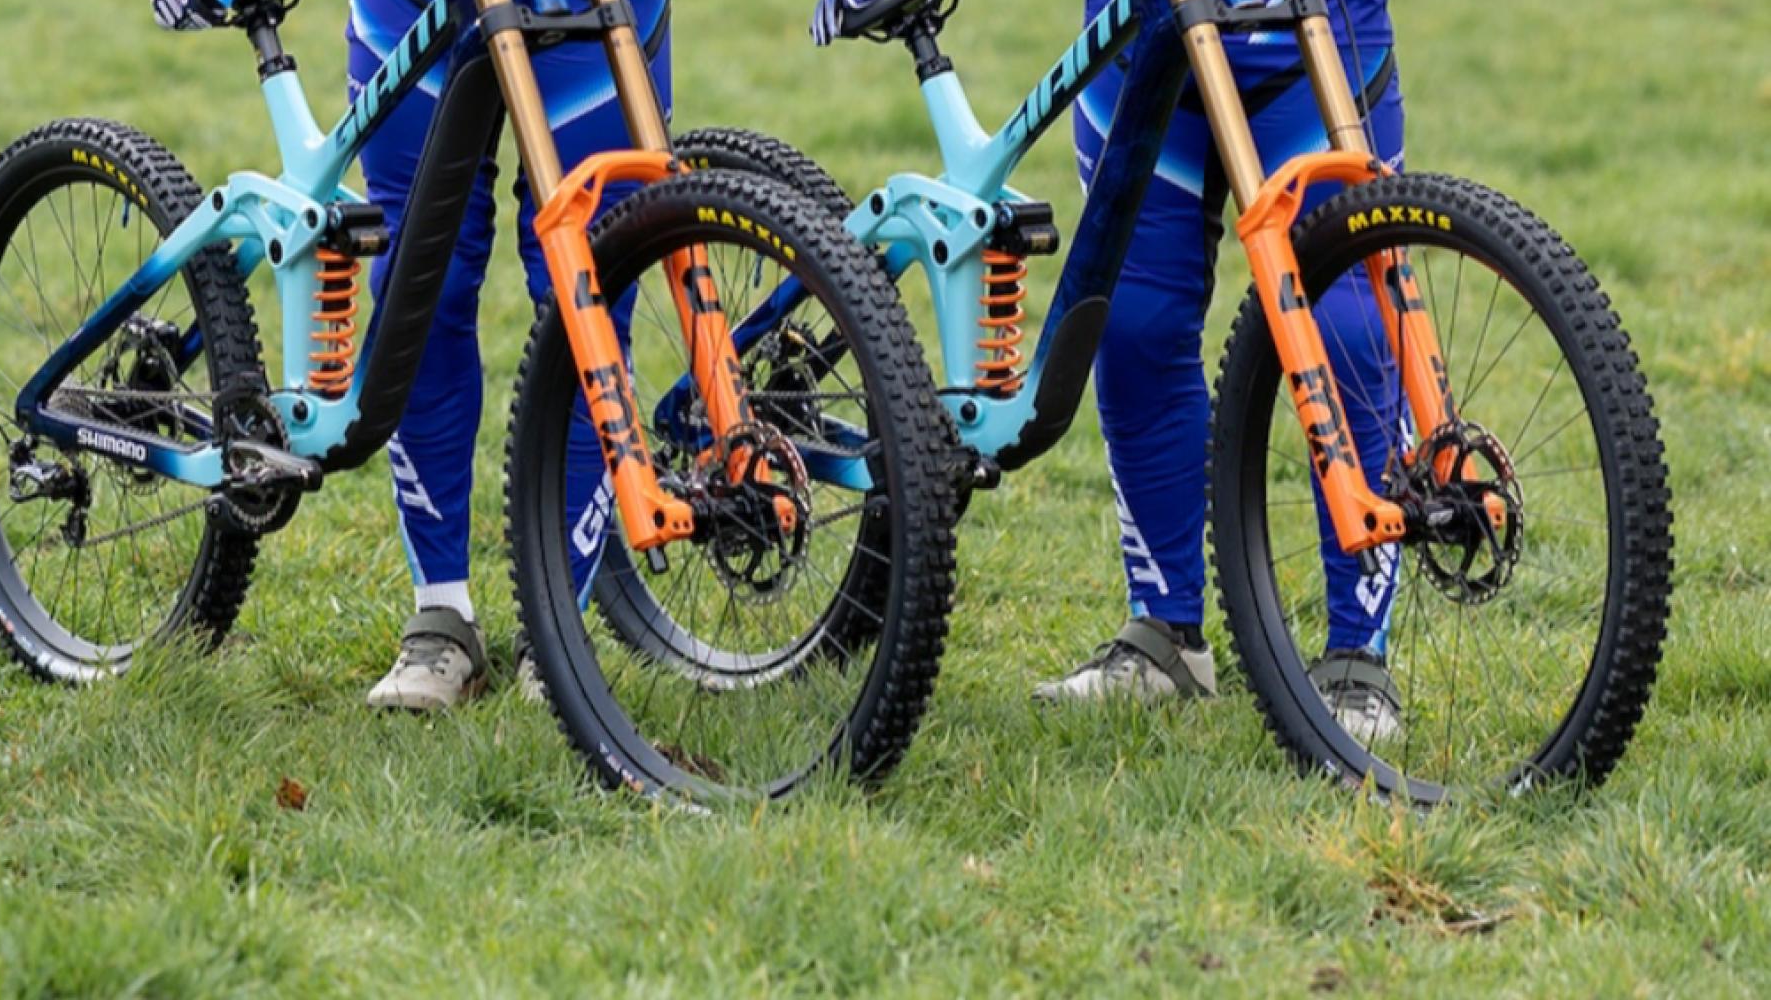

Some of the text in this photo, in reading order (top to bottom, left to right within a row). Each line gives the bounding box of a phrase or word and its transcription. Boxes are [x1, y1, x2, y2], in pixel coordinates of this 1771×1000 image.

[71, 147, 149, 207] MAXXIS
[697, 205, 796, 261] MAXXIS
[1347, 205, 1451, 233] MAXXIS
[77, 427, 147, 461] SHIMANO
